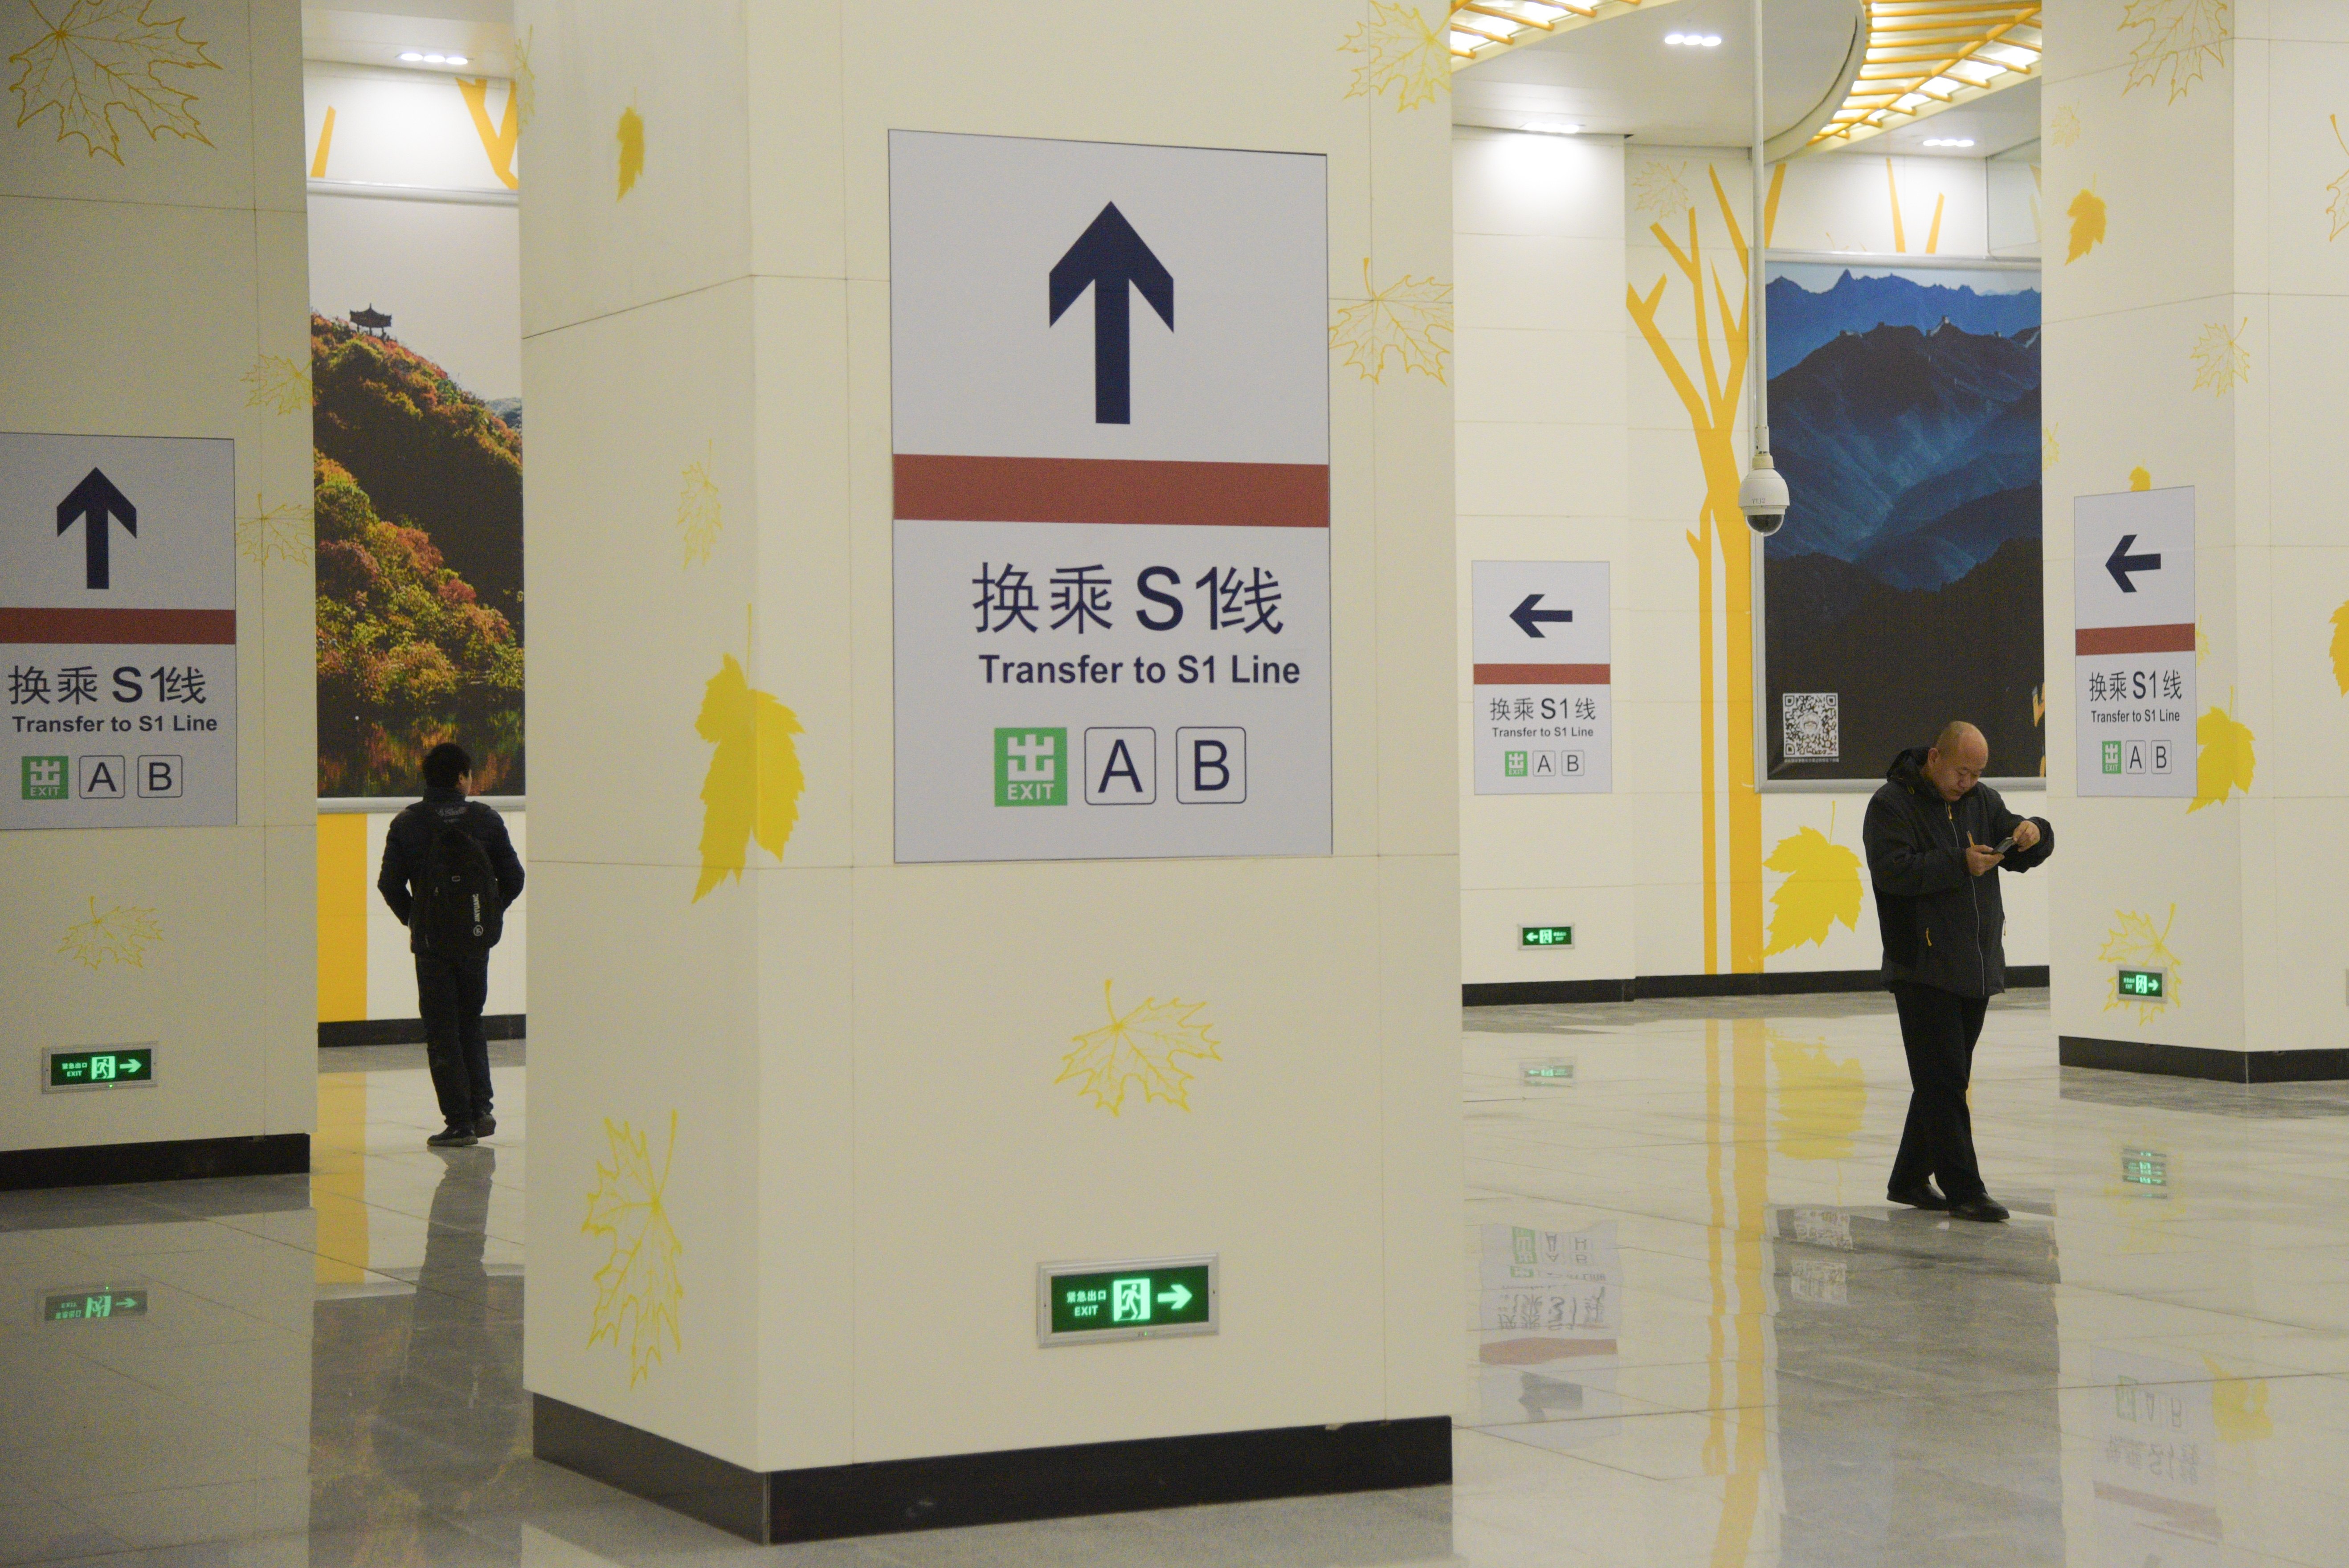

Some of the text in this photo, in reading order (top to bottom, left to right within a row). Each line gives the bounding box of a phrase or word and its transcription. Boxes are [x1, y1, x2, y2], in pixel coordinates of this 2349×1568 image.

[972, 562, 1283, 634] 换乘S1线
[978, 654, 1300, 684] Transfer to S1 Line
[8, 665, 206, 705] 换乘S1线
[2089, 670, 2182, 702] 换乘S1线
[1490, 697, 1596, 721] 换乘S1线
[2091, 709, 2180, 723] Transfer to S1 Line
[12, 715, 217, 732] Transfer to S1 Line
[1492, 727, 1593, 737] Transfer to S1 Line
[1098, 739, 1230, 793] A B
[1537, 755, 1579, 772] A B
[2130, 746, 2167, 769] A B
[87, 762, 172, 792] A B
[2106, 764, 2118, 772] EXIT
[30, 787, 60, 796] EXIT
[1008, 784, 1054, 800] EXIT
[1074, 1305, 1098, 1317] EXIT
